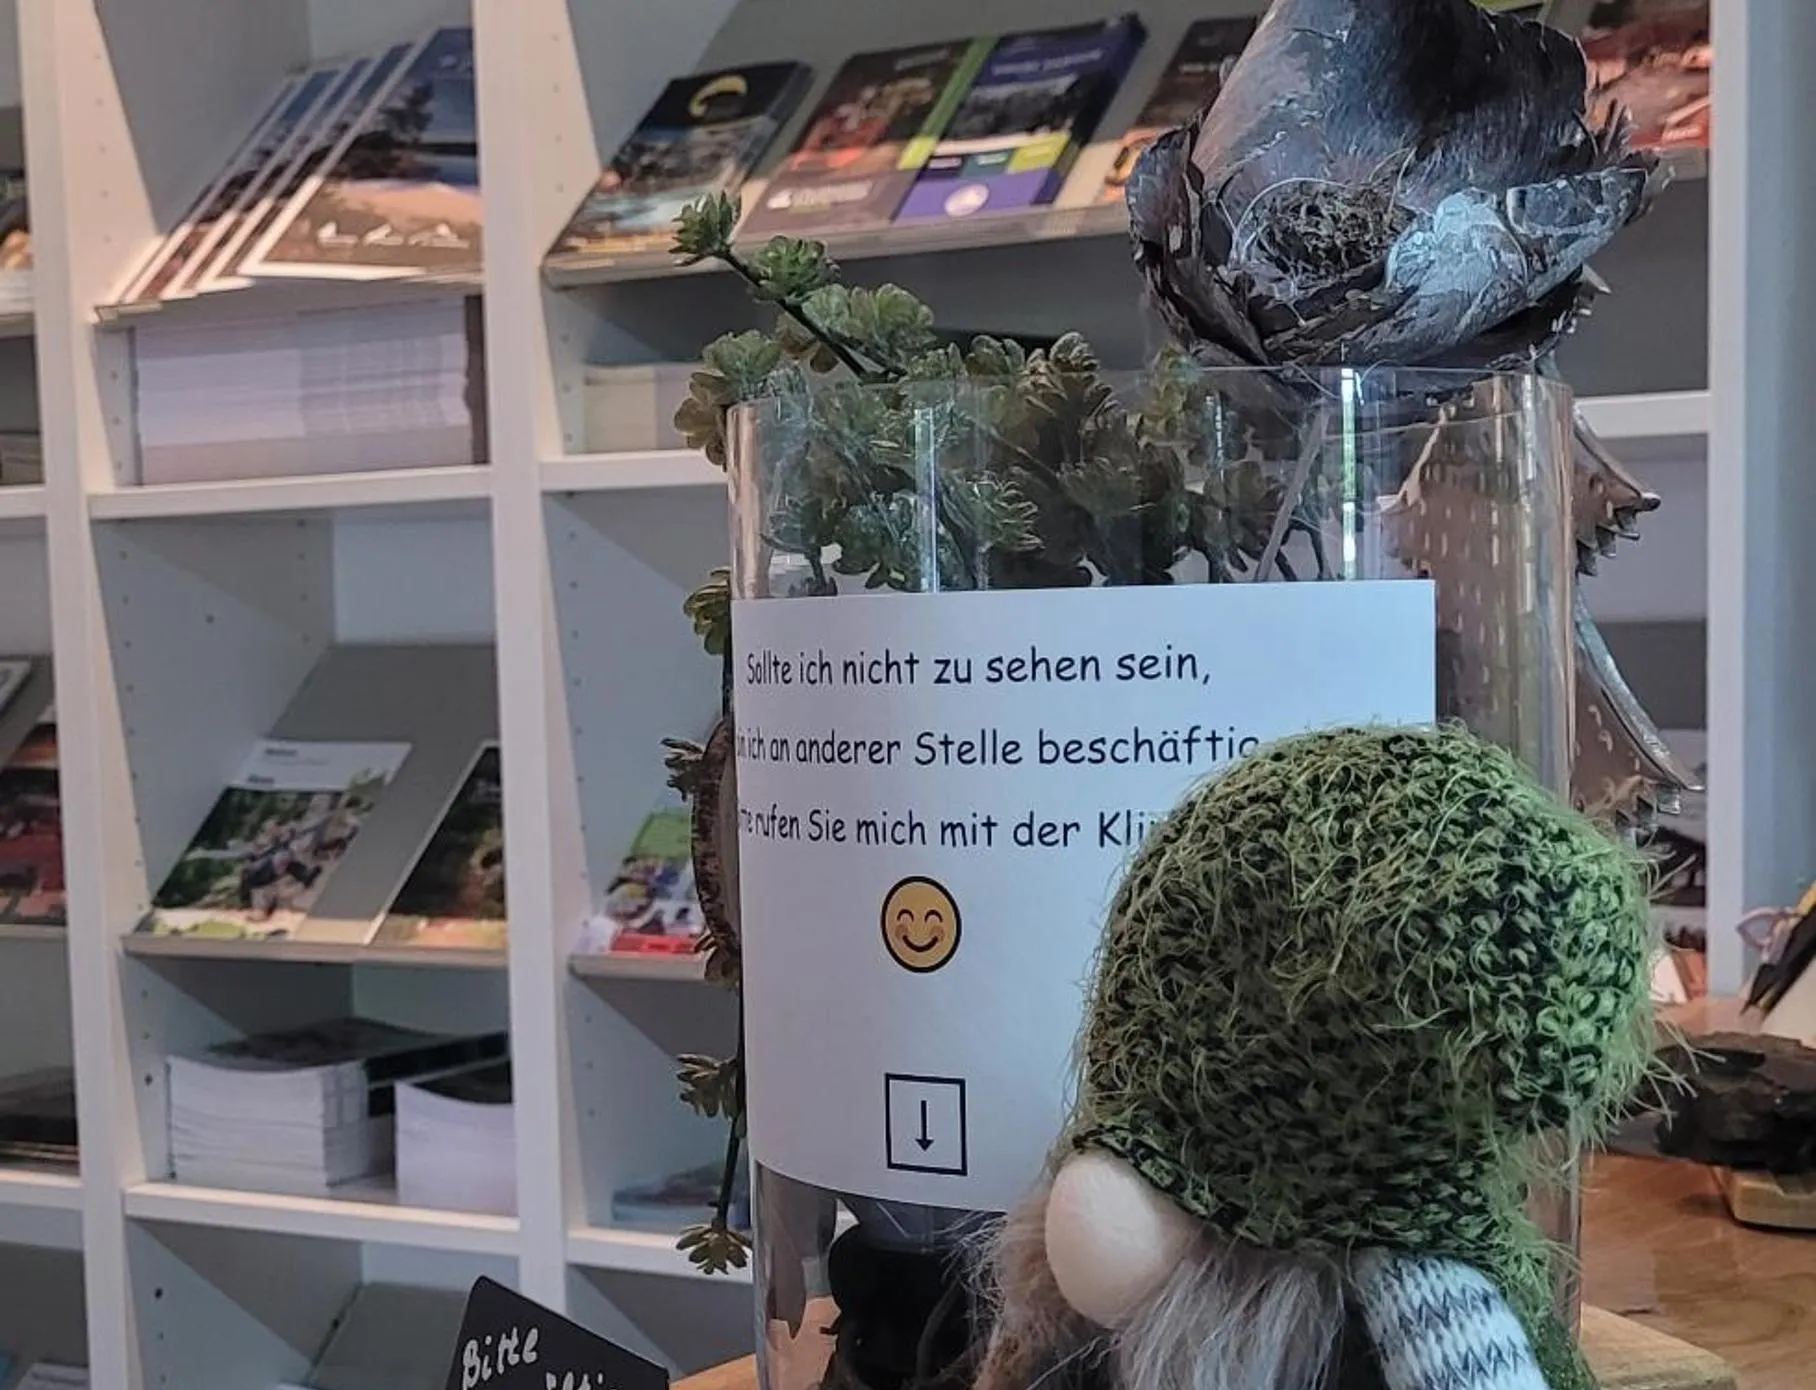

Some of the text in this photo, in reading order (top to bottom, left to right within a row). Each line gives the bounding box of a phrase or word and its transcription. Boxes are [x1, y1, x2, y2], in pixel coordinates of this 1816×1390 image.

[746, 644, 1211, 685] Sollte ich nicht zu sehen sein,
[770, 737, 791, 763] an
[795, 728, 901, 765] anderer
[914, 728, 1023, 766] Stelle
[755, 803, 801, 841] rufen
[807, 808, 847, 843] Sie
[855, 808, 927, 847] mich
[939, 812, 998, 848] mit
[1012, 810, 1082, 848] der
